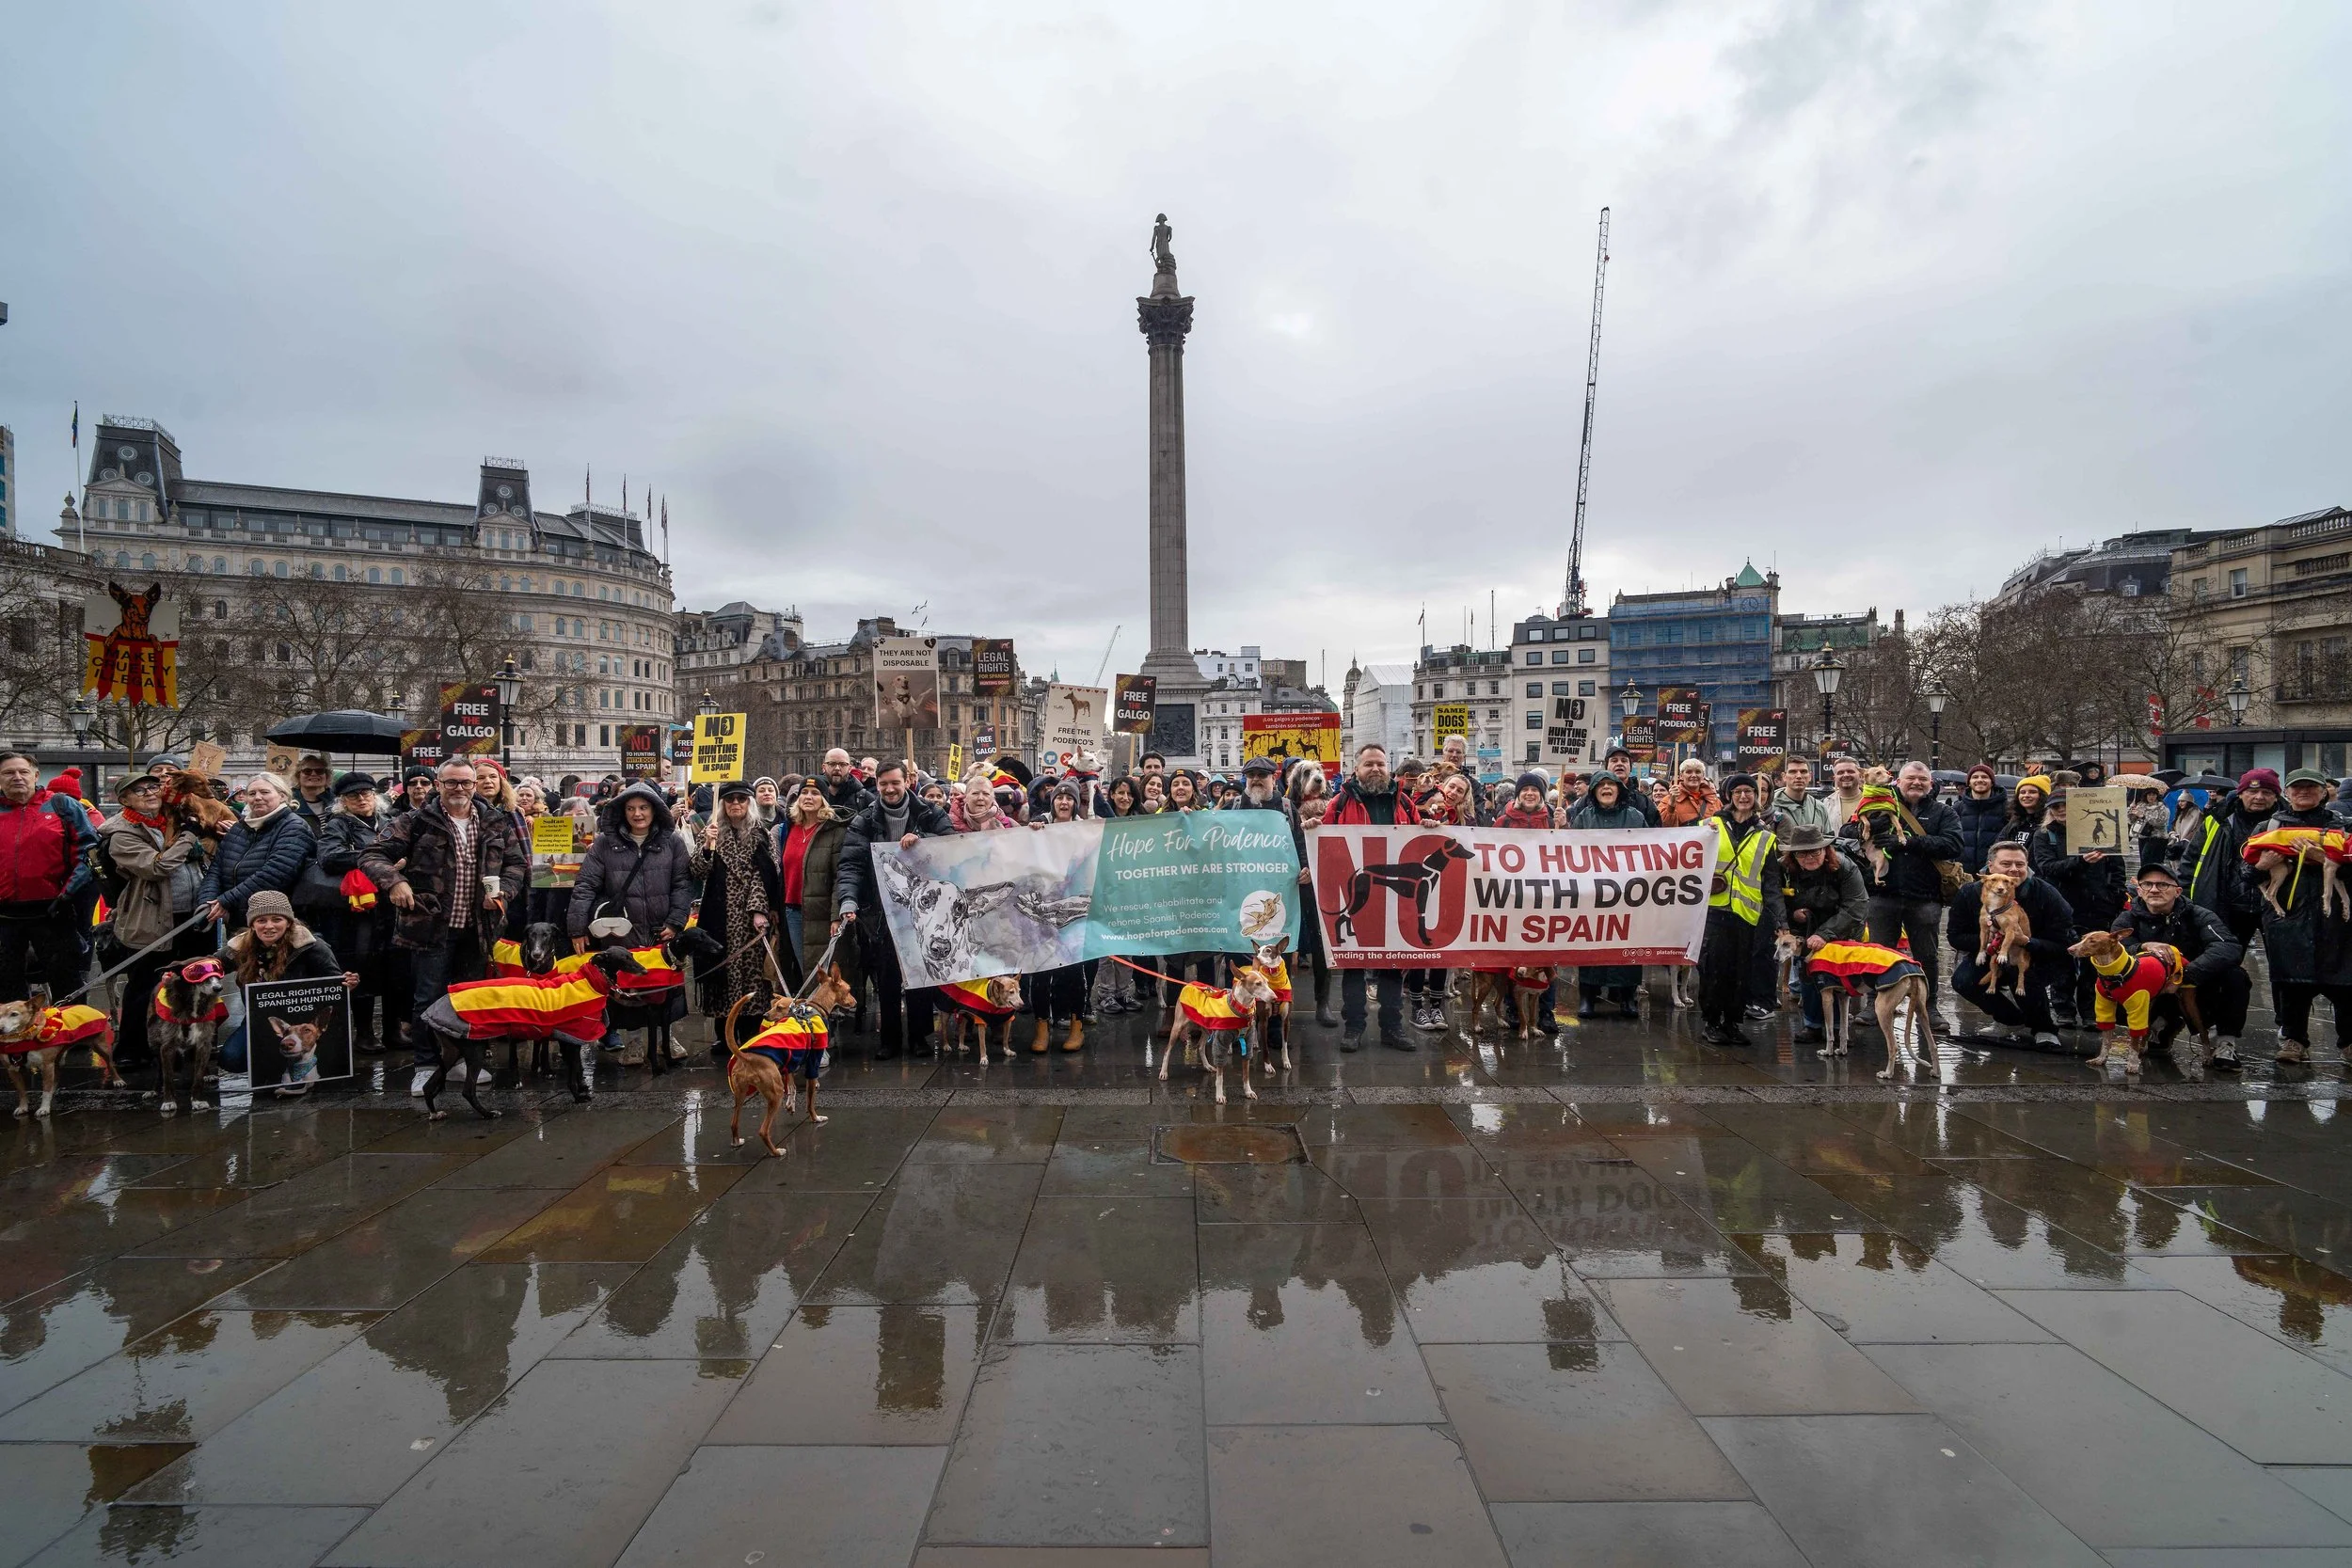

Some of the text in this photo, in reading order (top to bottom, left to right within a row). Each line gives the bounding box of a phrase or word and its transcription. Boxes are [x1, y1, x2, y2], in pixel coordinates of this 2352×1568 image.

[106, 648, 157, 662] MAKE
[978, 652, 1009, 662] LEGAL
[92, 657, 170, 675] CRUELTY
[978, 663, 1009, 673] RIGHTS
[94, 669, 167, 689] ILLEGAL
[1123, 691, 1148, 702] FREE
[454, 703, 488, 715] FREE
[1555, 698, 1585, 720] NO
[1666, 704, 1691, 713] FREE
[1118, 709, 1151, 721] GALGO
[1438, 715, 1464, 727] DOGS
[446, 725, 495, 737] GALGO
[705, 716, 735, 736] NO
[1628, 726, 1653, 735] LEGAL
[1747, 726, 1776, 736] FREE
[1549, 727, 1587, 738] HUNTING
[631, 736, 651, 751] NO
[1053, 737, 1093, 746] PODENCO'S
[1548, 736, 1586, 747] WITH DOGS
[412, 747, 442, 757] FREE
[699, 744, 738, 754] HUNTING
[1740, 746, 1783, 754] PODENCO
[698, 755, 716, 764] WITH
[1658, 752, 1667, 762] NO
[711, 763, 730, 771] SPAIN
[1107, 826, 1290, 862] Hope For Podencos
[1473, 841, 1704, 873] TO HUNTING
[1115, 863, 1289, 880] TOGETHER WE ARE STRONGER
[1318, 835, 1468, 949] NO
[1473, 876, 1703, 910] WITH DOGS
[1120, 902, 1152, 911] rescue,
[1154, 897, 1204, 908] rehabilitate
[1207, 895, 1223, 904] and
[1108, 911, 1220, 927] rehome Spanish Podencos
[1102, 927, 1228, 941] www.hopeforpodencos.com
[1470, 914, 1631, 943] IN SPAIN
[257, 991, 286, 1000] LEGAL
[289, 988, 322, 997] RIGHTS
[258, 994, 342, 1007] SPANISH HUNTING
[288, 1005, 313, 1013] DOGS
